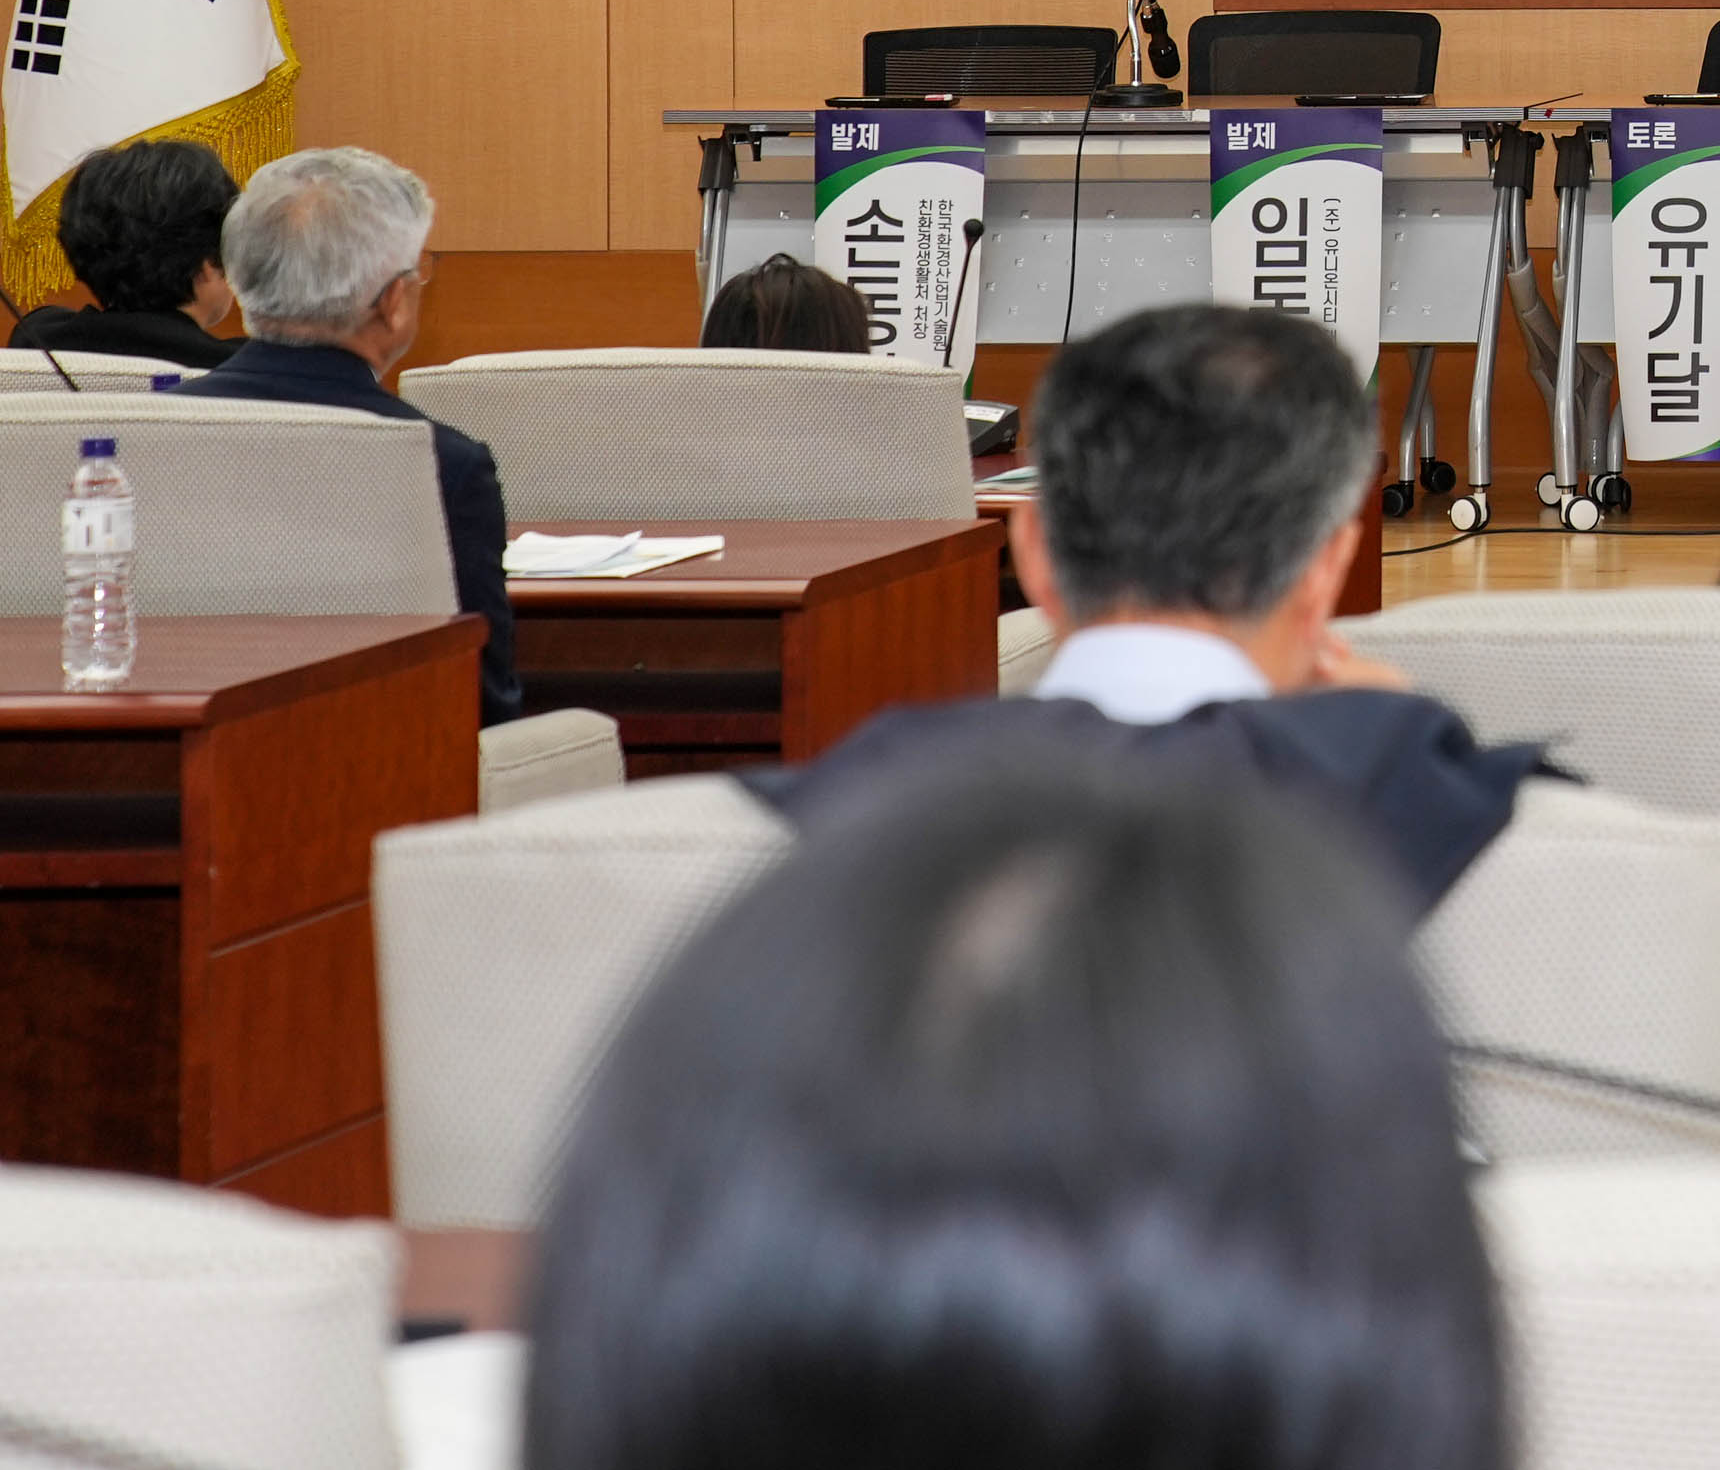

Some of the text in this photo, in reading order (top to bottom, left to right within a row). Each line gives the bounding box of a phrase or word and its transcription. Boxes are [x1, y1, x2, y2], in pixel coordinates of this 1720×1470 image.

[831, 122, 880, 152] 발제
[1226, 121, 1276, 151] 발제
[1626, 121, 1677, 150] 토론
[844, 199, 905, 357] 손동
[913, 198, 933, 340] 친환경생활처 처장
[933, 198, 954, 352] 한국환경산업기술원
[1647, 197, 1710, 423] 유기달
